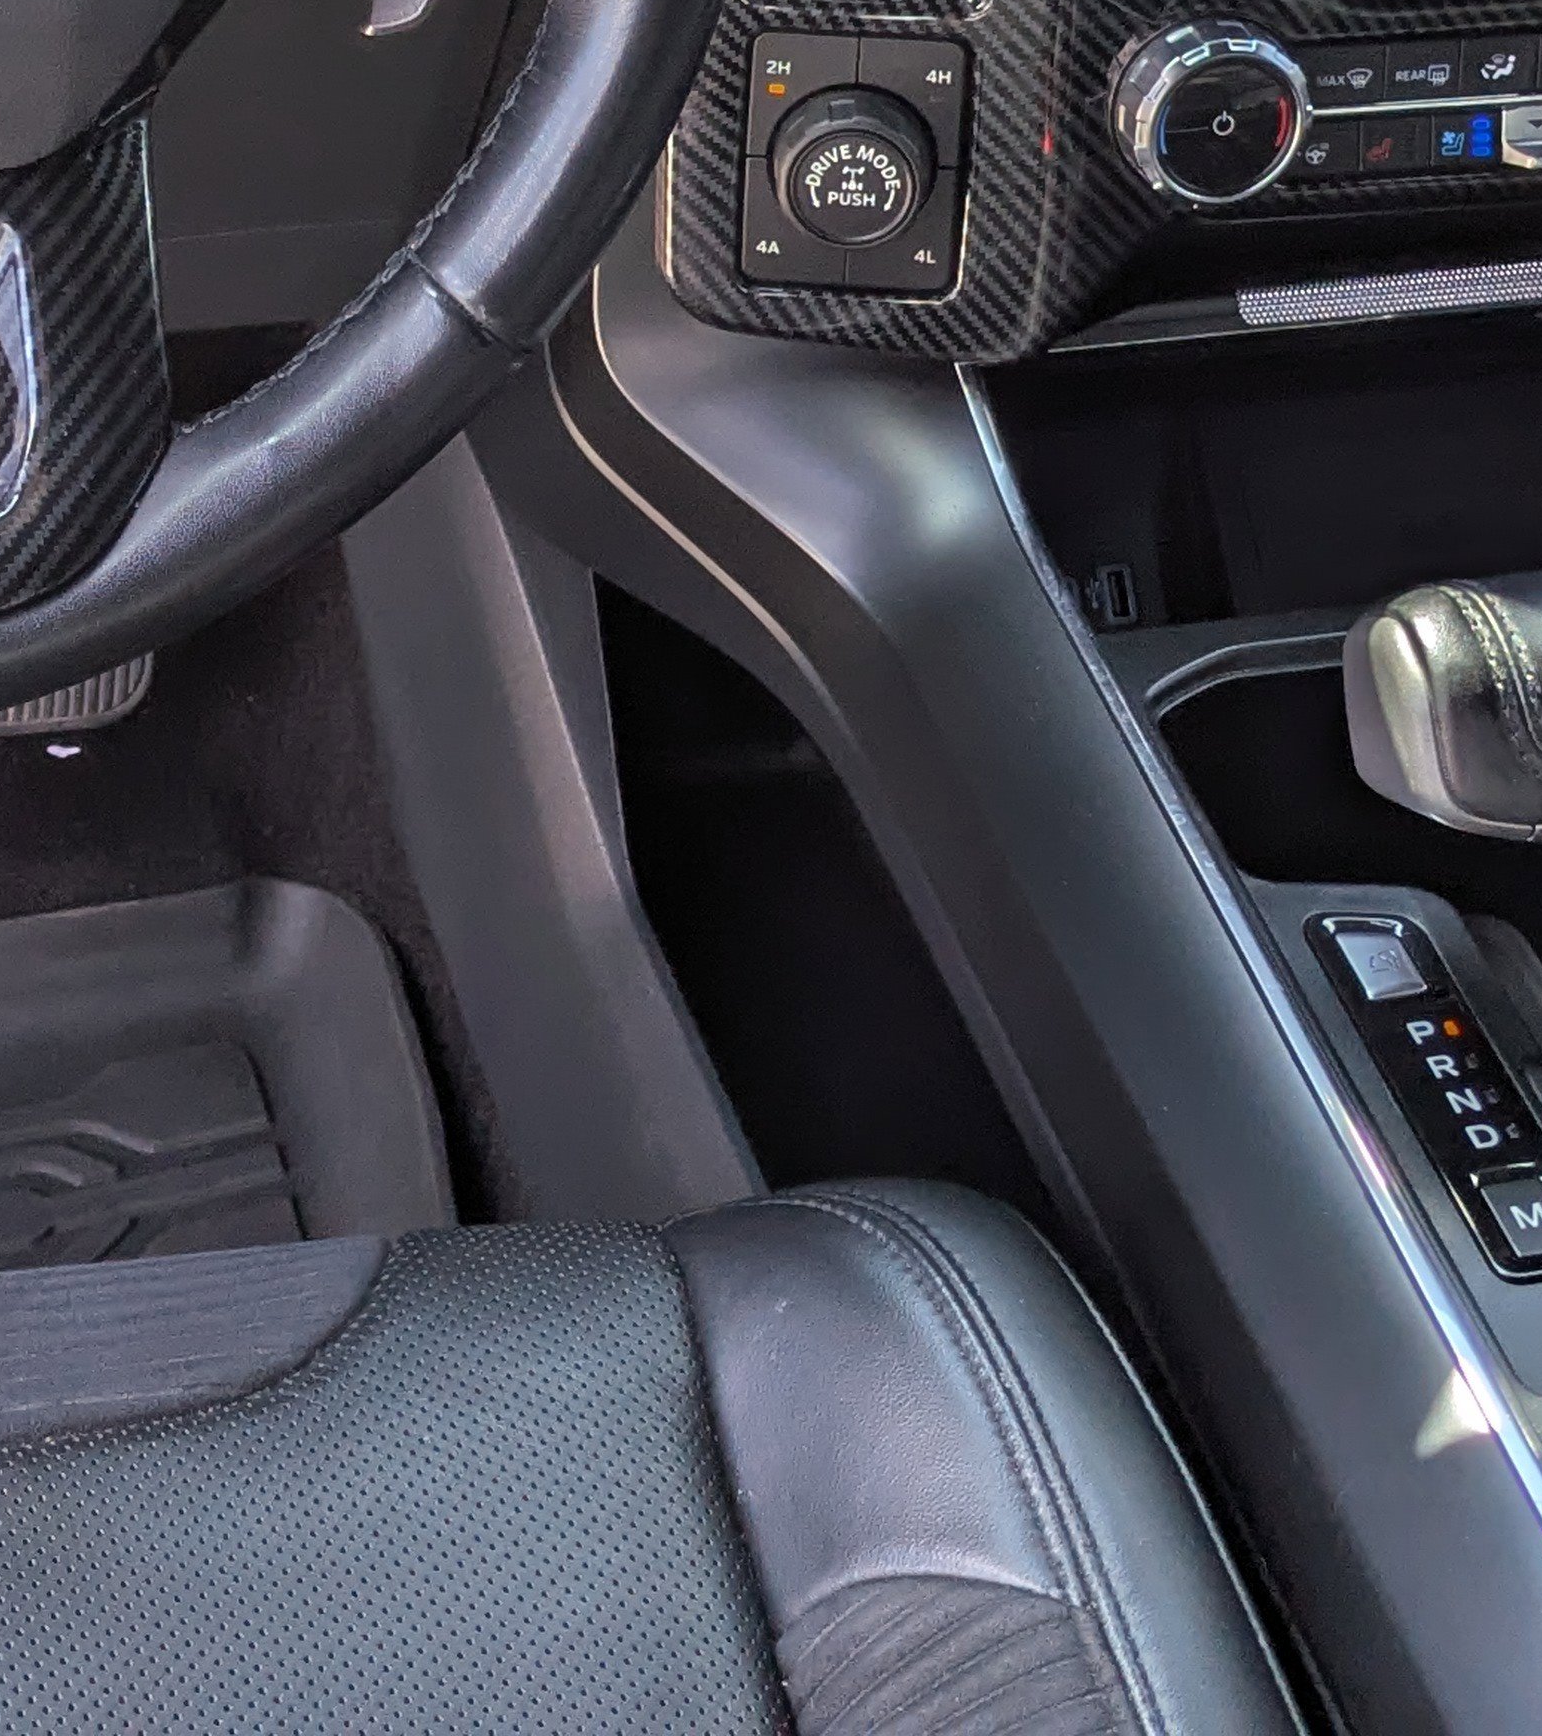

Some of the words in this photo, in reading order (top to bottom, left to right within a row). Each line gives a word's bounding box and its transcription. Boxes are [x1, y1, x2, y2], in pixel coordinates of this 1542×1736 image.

[766, 60, 792, 75] 2H
[1395, 69, 1426, 82] REAR
[925, 70, 952, 85] 4H
[805, 144, 852, 188] DRIVE
[856, 145, 901, 191] MODE
[827, 190, 876, 207] PUSH
[756, 240, 780, 254] 4A
[914, 249, 936, 264] 4L
[1406, 1020, 1436, 1045] P
[1426, 1054, 1459, 1079] R
[1446, 1088, 1482, 1114] N
[1465, 1123, 1501, 1150] D
